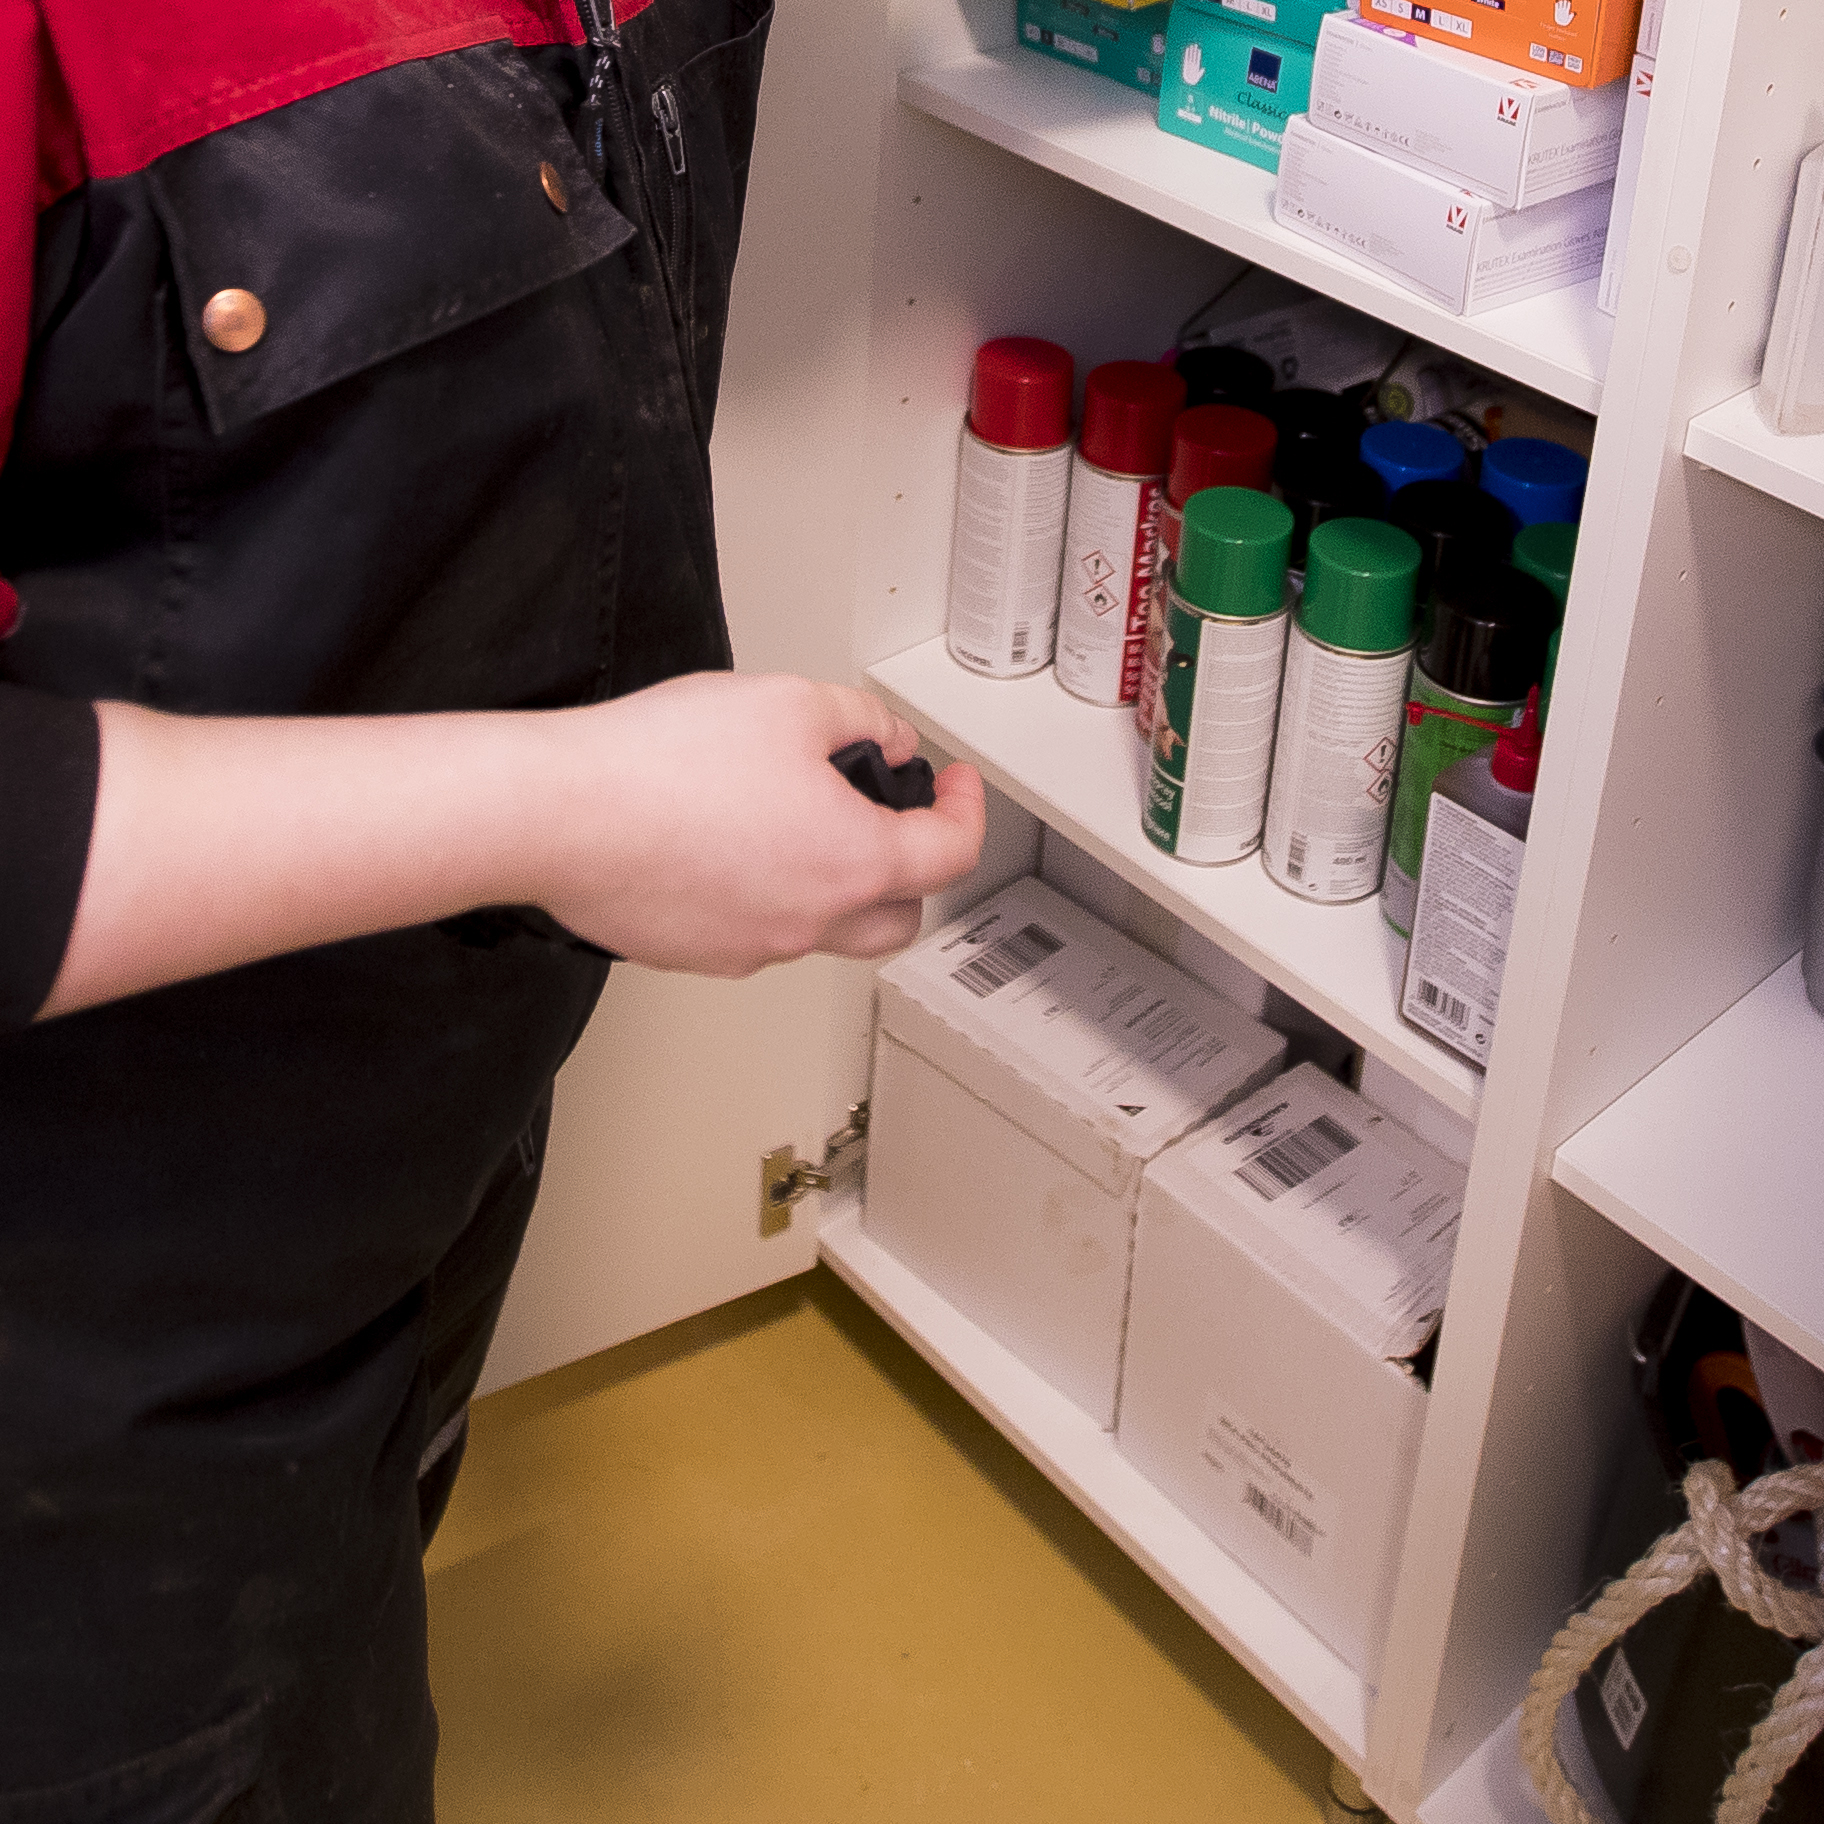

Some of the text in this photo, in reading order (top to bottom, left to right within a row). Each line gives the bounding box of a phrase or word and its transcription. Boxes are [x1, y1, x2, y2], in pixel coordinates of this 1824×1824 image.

[1261, 5, 1273, 18] XL
[1397, 2, 1405, 14] S
[1414, 7, 1427, 22] M
[1438, 14, 1445, 26] L
[1455, 19, 1469, 34] XL
[1207, 104, 1247, 131] Nitrile
[1475, 256, 1511, 275] KRUTEX
[1511, 238, 1564, 264] Examination
